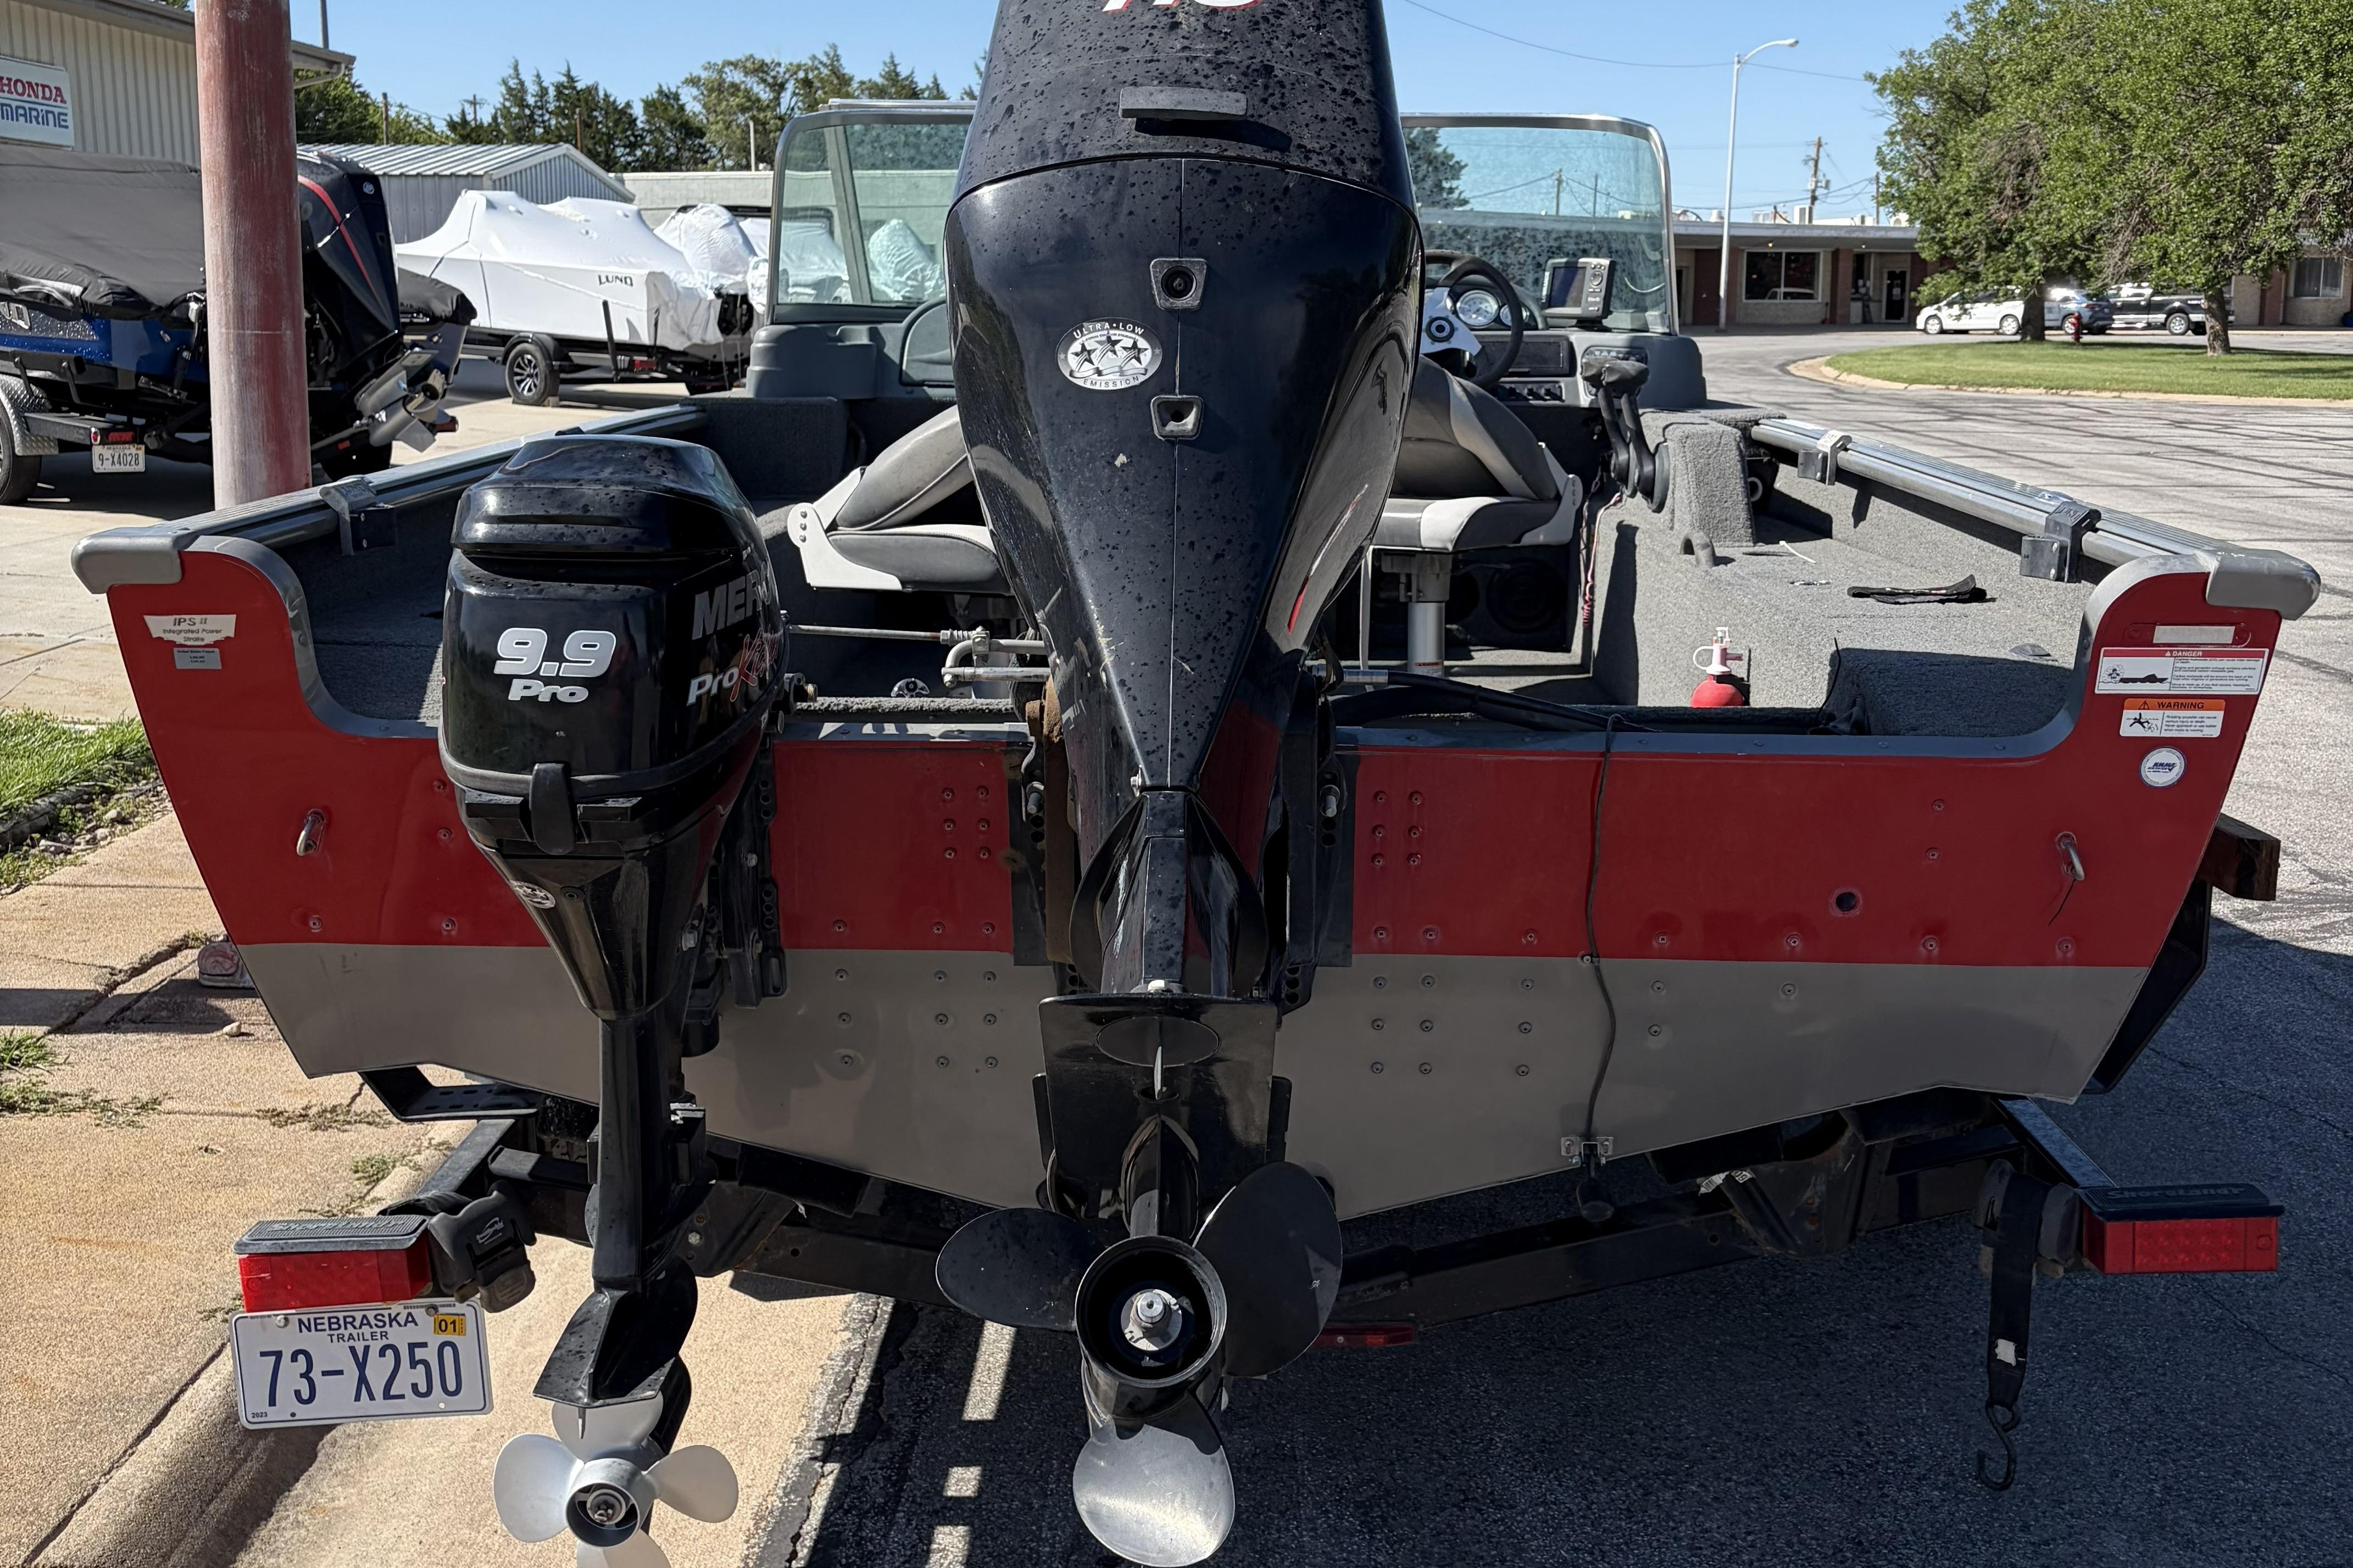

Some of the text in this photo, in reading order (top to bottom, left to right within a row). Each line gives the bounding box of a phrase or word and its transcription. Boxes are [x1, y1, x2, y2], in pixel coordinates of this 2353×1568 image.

[0, 76, 66, 104] HONDA
[598, 274, 633, 287] LUND
[1083, 375, 1139, 388] EMISSION
[98, 453, 140, 467] 9-X4028
[173, 617, 197, 627] IPS
[493, 627, 616, 678] 9.9
[508, 679, 589, 703] Pro
[2157, 701, 2205, 710] WARNING
[298, 1312, 419, 1333] NEBRASKA
[438, 1319, 457, 1333] 01
[327, 1331, 390, 1343] TRAILER
[259, 1340, 463, 1407] 73-X250
